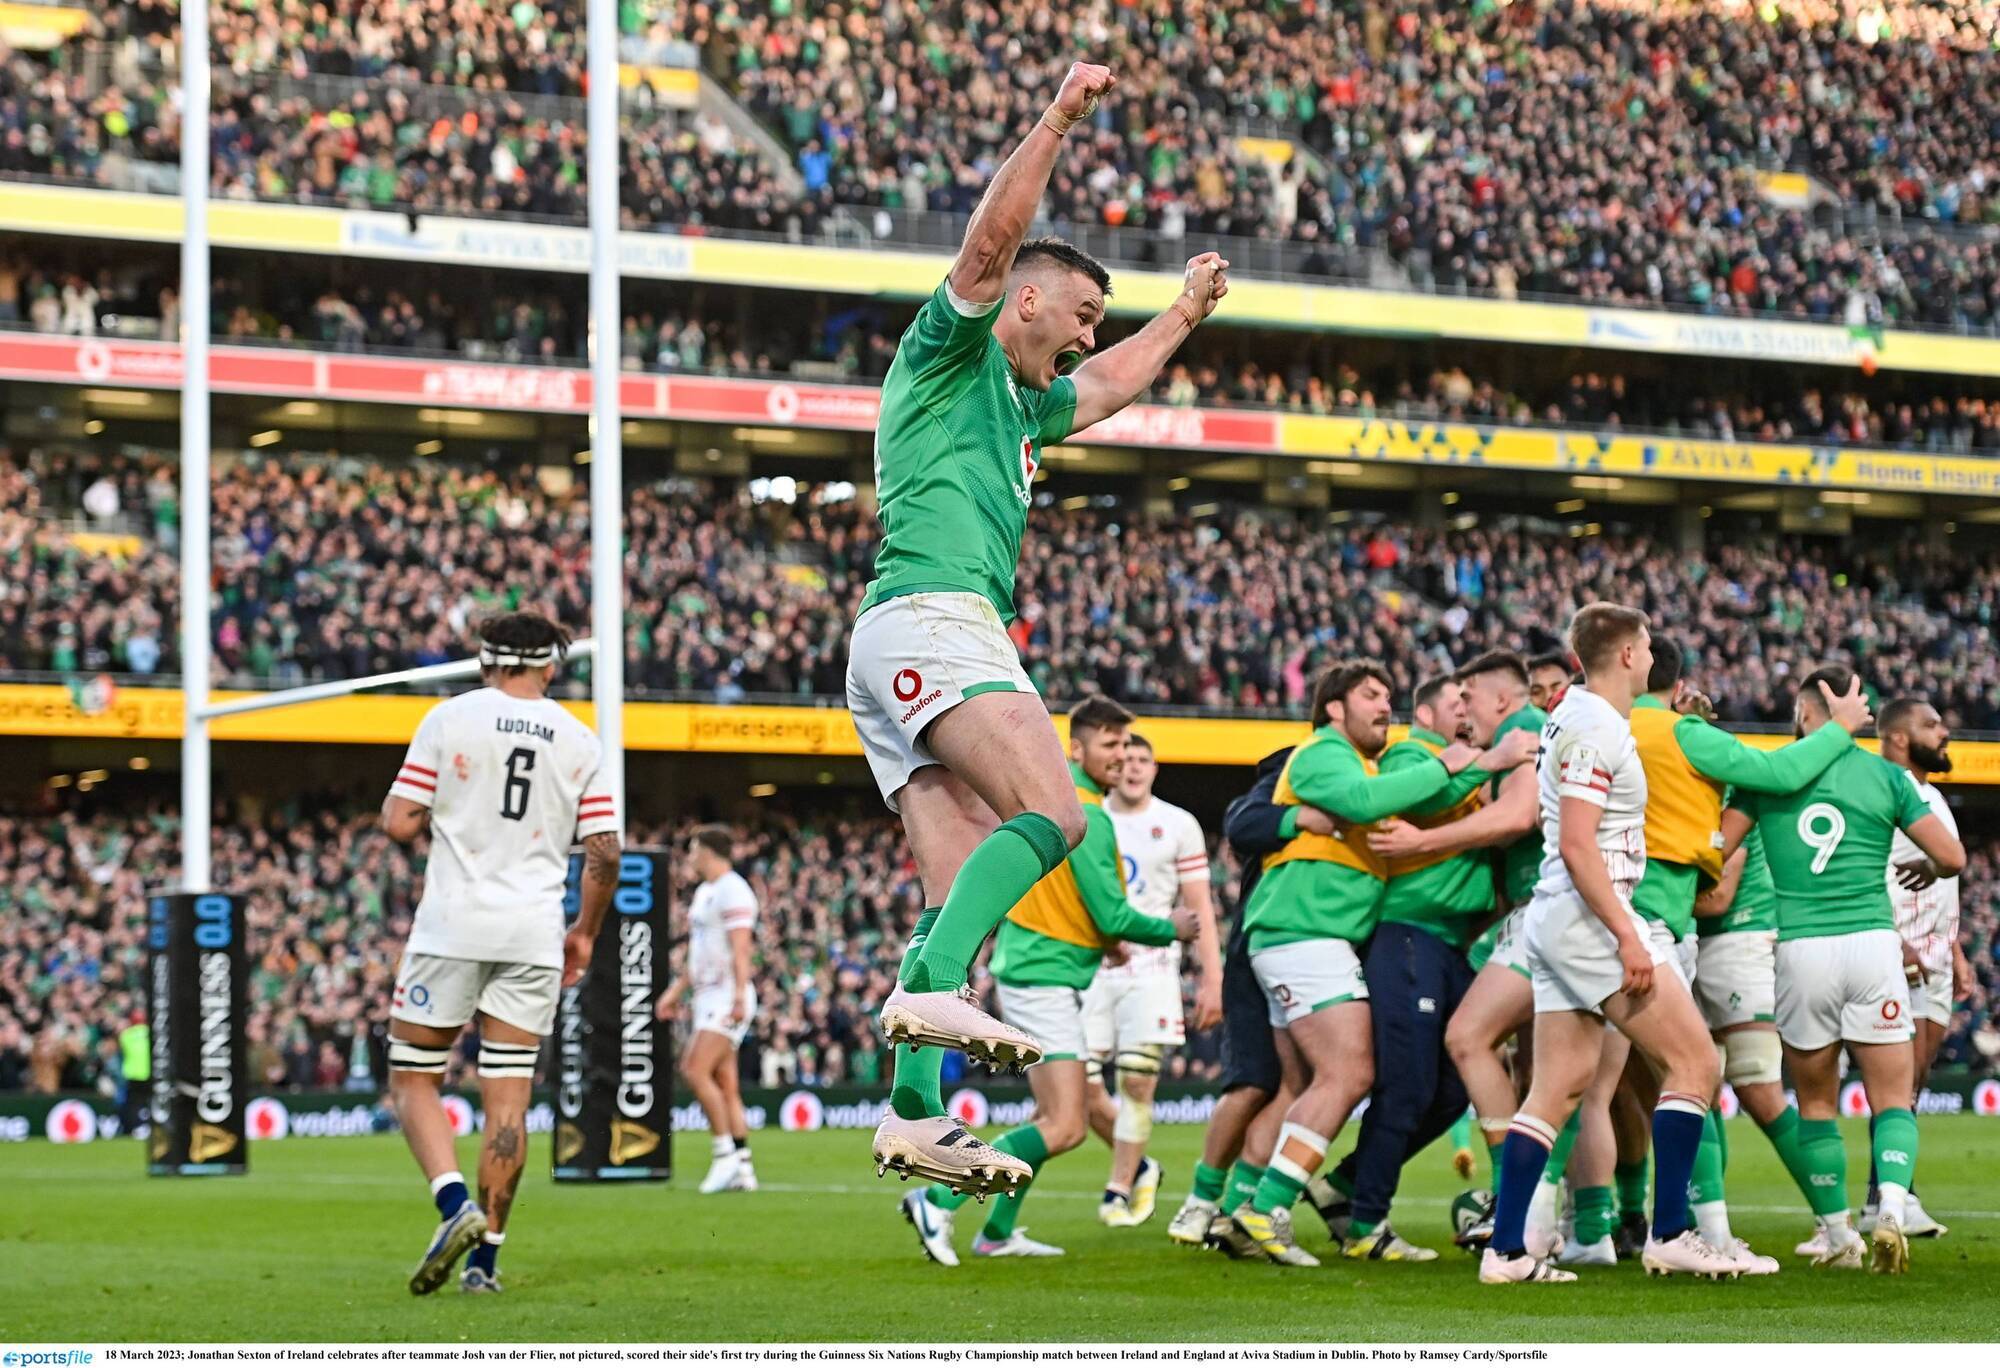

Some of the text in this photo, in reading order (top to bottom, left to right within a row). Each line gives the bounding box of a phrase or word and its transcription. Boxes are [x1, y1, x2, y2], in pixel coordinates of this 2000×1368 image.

[1672, 443, 1755, 471] AVIVA
[1857, 458, 1922, 483] Home
[900, 688, 943, 725] vodafone
[496, 717, 555, 743] LUDLAM
[499, 747, 536, 822] 6
[1797, 802, 1846, 876] 9
[616, 920, 653, 1119] GUINNESS
